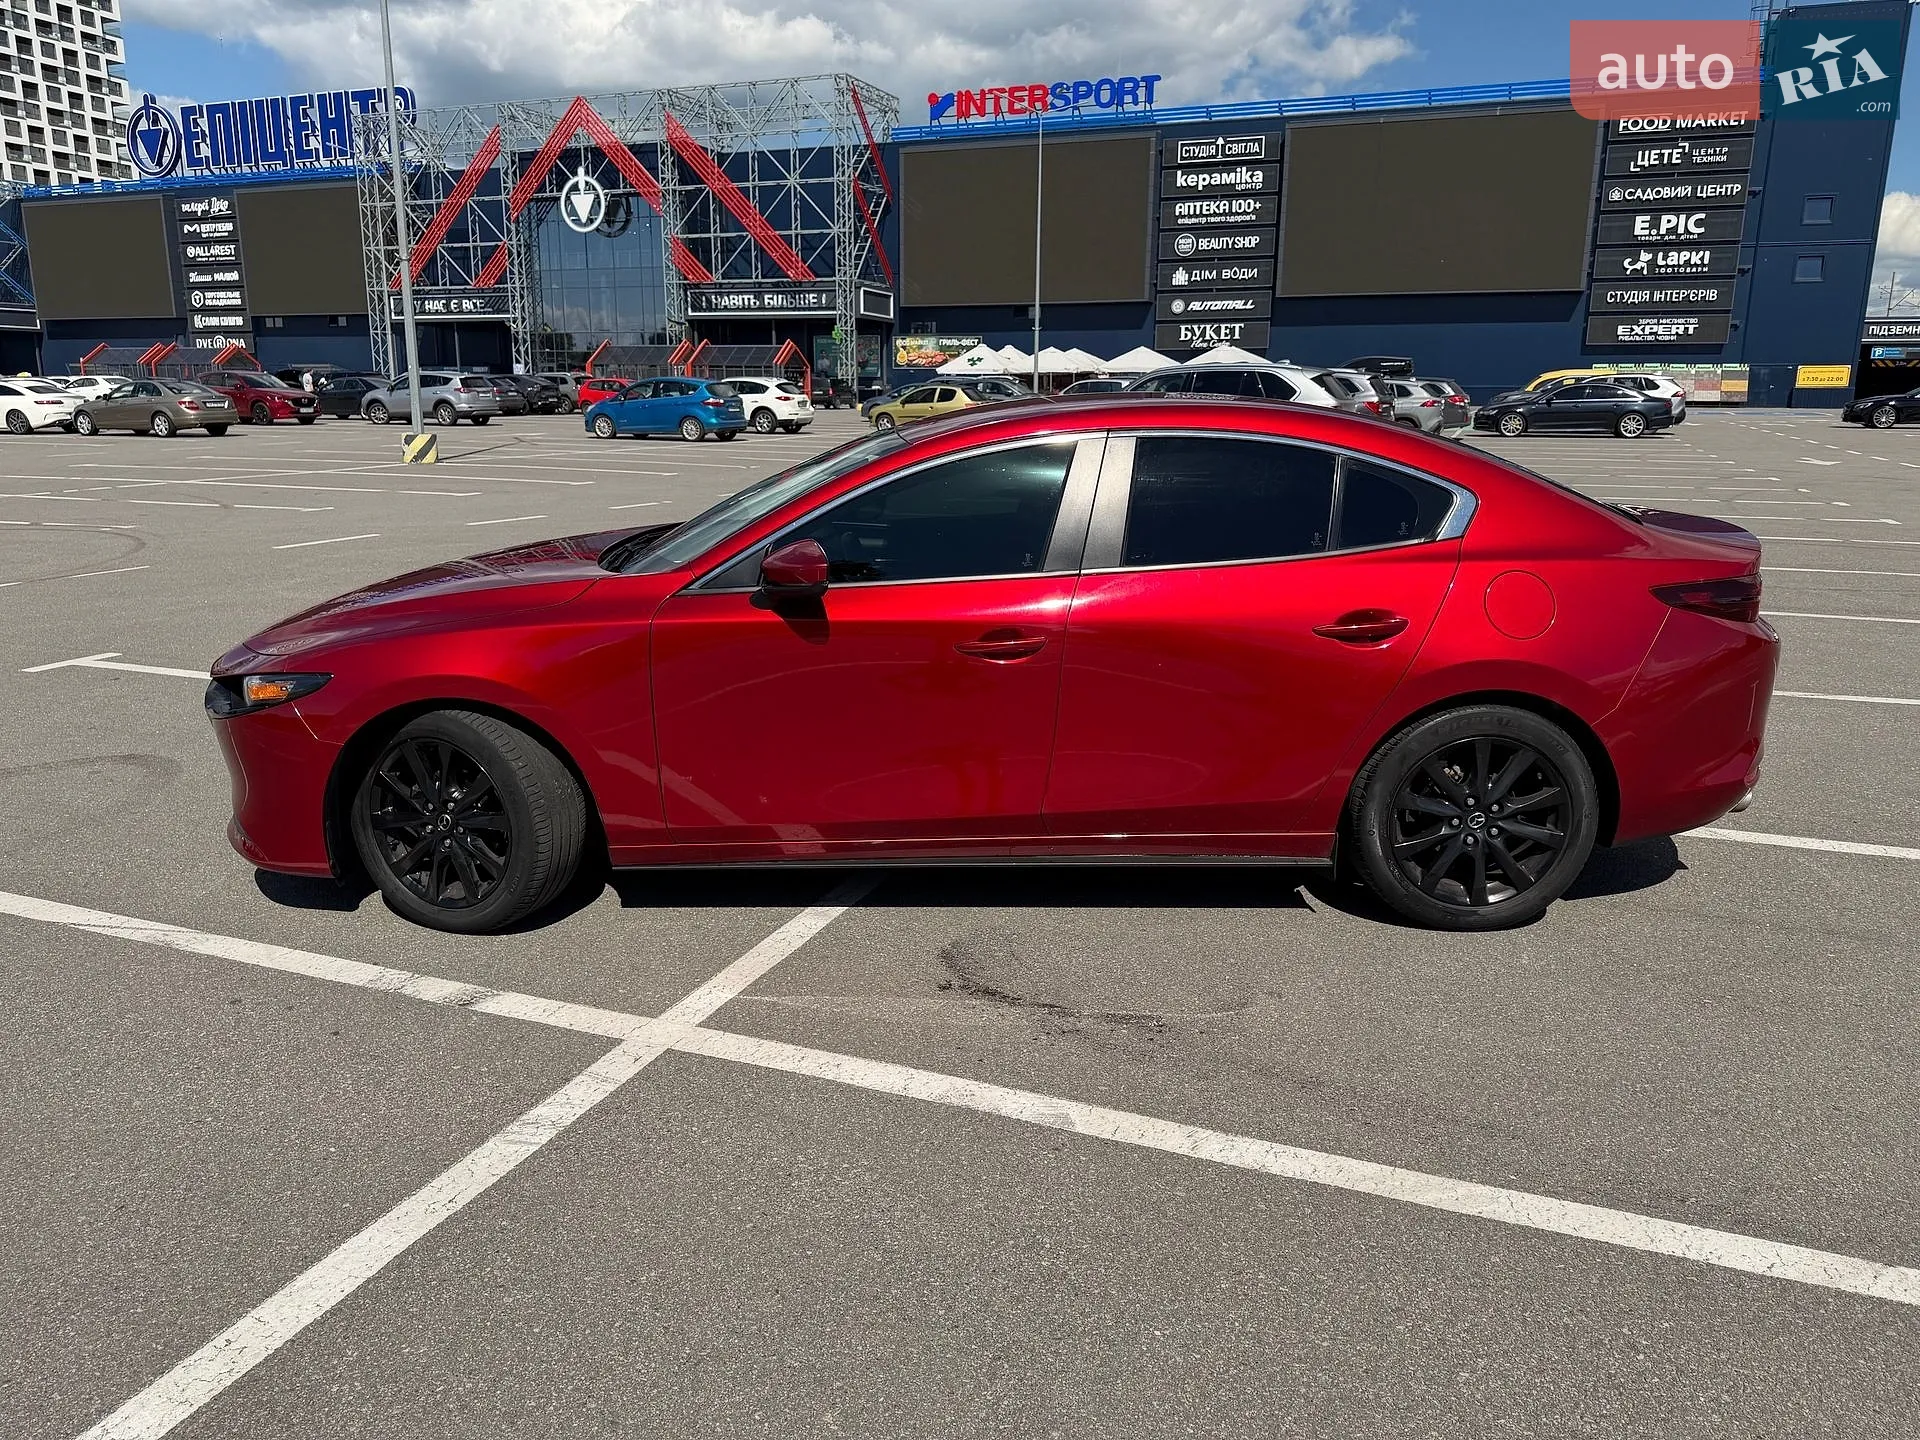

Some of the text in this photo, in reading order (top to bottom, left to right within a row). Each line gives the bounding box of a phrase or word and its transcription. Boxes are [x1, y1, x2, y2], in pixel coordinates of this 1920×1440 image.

[956, 75, 1162, 119] INTERSPORT
[180, 85, 417, 170] ЕПІЦЕНТР
[1619, 111, 1749, 133] FOOD MARKET
[1182, 142, 1260, 158] СТУДІЯ СВІТЛА
[1637, 148, 1683, 167] ЦЕТЕ
[1692, 147, 1729, 156] ЦЕНТР
[1692, 155, 1728, 164] ТЕХНІКИ
[1624, 184, 1742, 201] САДОВИЙ ЦЕНТР
[1175, 199, 1262, 216] АПТЕКА 100+
[1633, 213, 1707, 236] E.PIC
[195, 245, 236, 257] ALL4REST
[1198, 236, 1260, 250] BEAUTY SHOP
[1190, 266, 1258, 282] ДІМ ВОДИ
[711, 294, 760, 309] НАВІТЬ
[764, 293, 819, 308] БІЛЬШЕ
[1186, 299, 1255, 311] AUTOMALL
[1606, 290, 1650, 304] СТУДІЯ
[1179, 323, 1245, 342] БУКЕТ
[1617, 324, 1699, 336] EXPERT
[1868, 325, 1920, 336] ПІДЗЕМН
